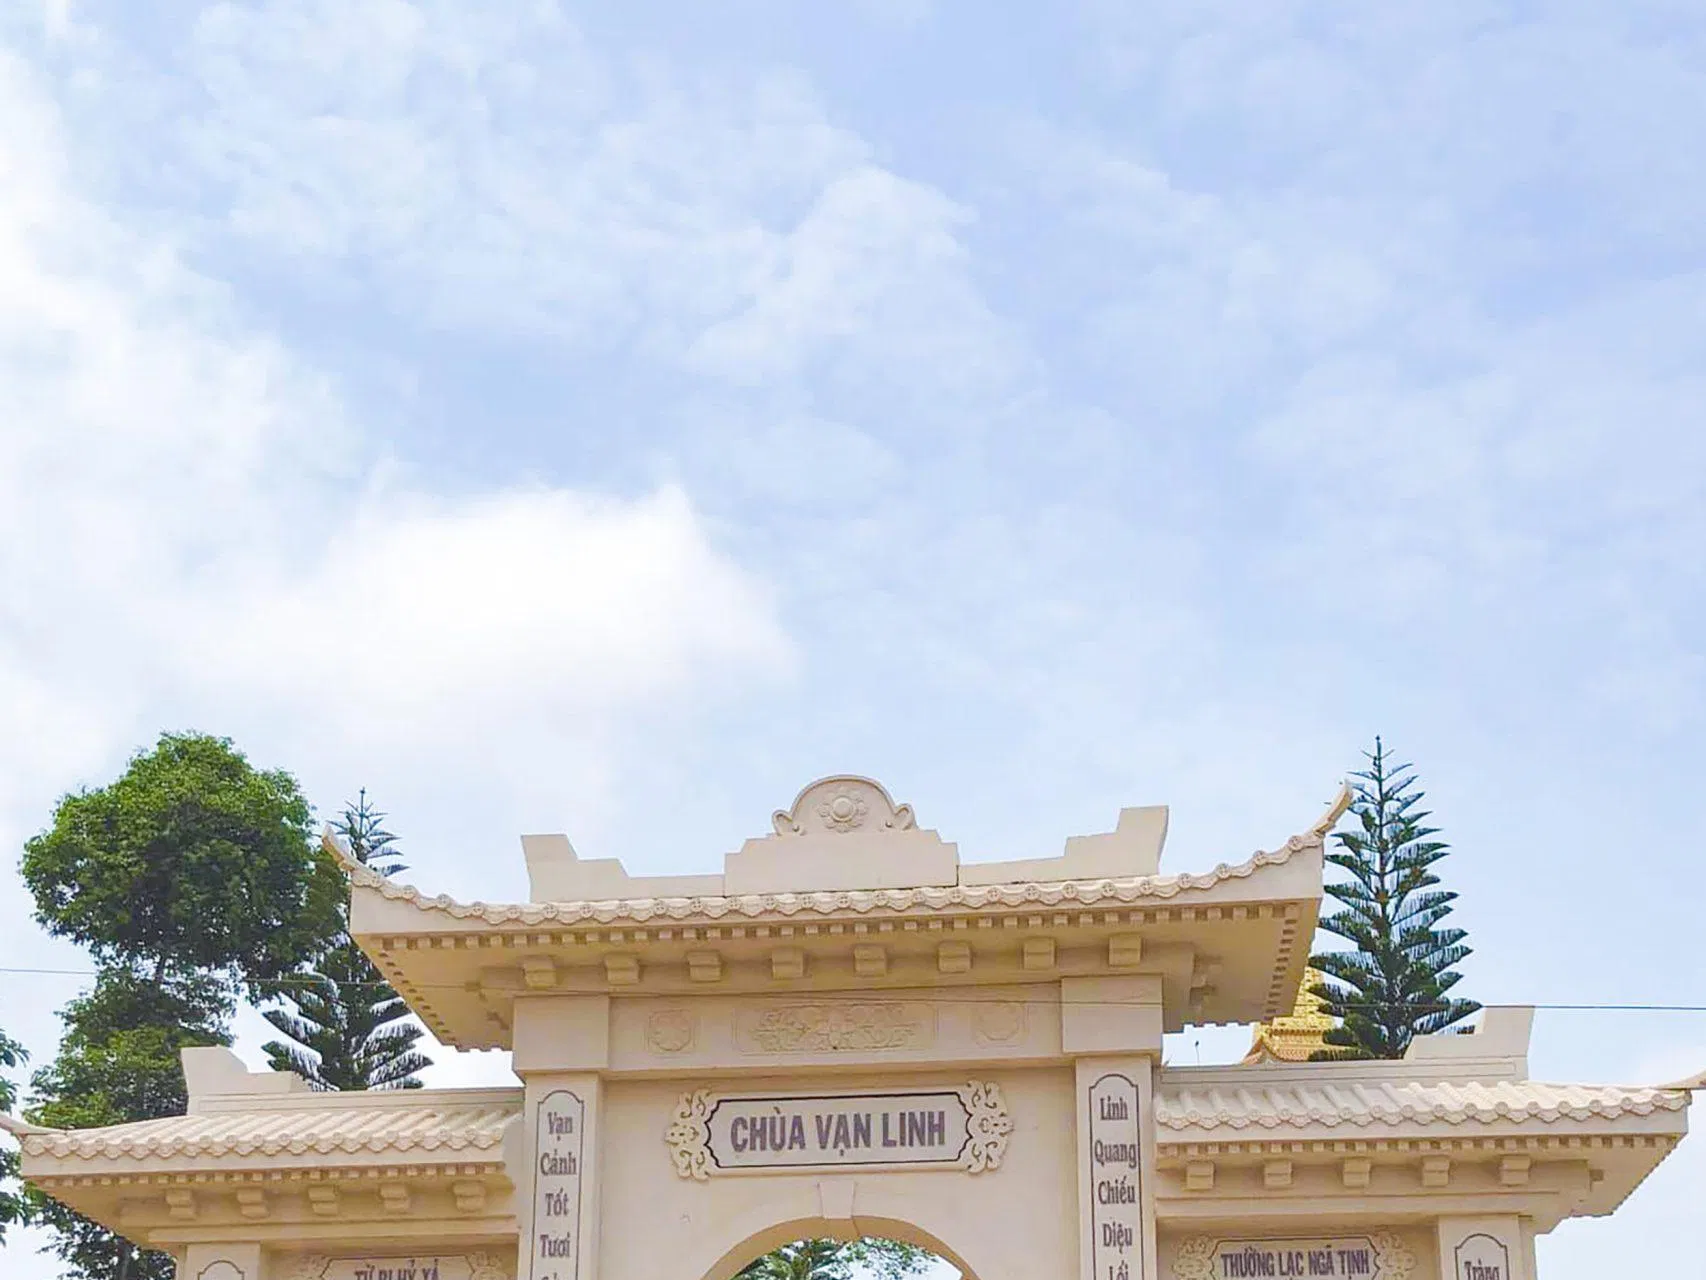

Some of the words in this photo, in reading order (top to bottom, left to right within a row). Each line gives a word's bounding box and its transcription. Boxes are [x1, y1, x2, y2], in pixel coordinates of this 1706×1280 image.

[1099, 1095, 1128, 1121] Linh
[547, 1111, 573, 1141] Vạn
[731, 1106, 806, 1152] CHÙA
[815, 1113, 871, 1156] VẠN
[882, 1111, 945, 1148] LINH
[540, 1149, 577, 1176] Cảnh
[1094, 1140, 1137, 1169] Quang
[545, 1188, 570, 1216] Tốt
[1098, 1175, 1136, 1205] Chiếu
[539, 1232, 571, 1258] Tươi
[1102, 1222, 1133, 1254] Diệu
[1220, 1246, 1276, 1277] THƯỜNG
[1308, 1244, 1334, 1276] NGÃ
[1338, 1249, 1370, 1280] TỊNH
